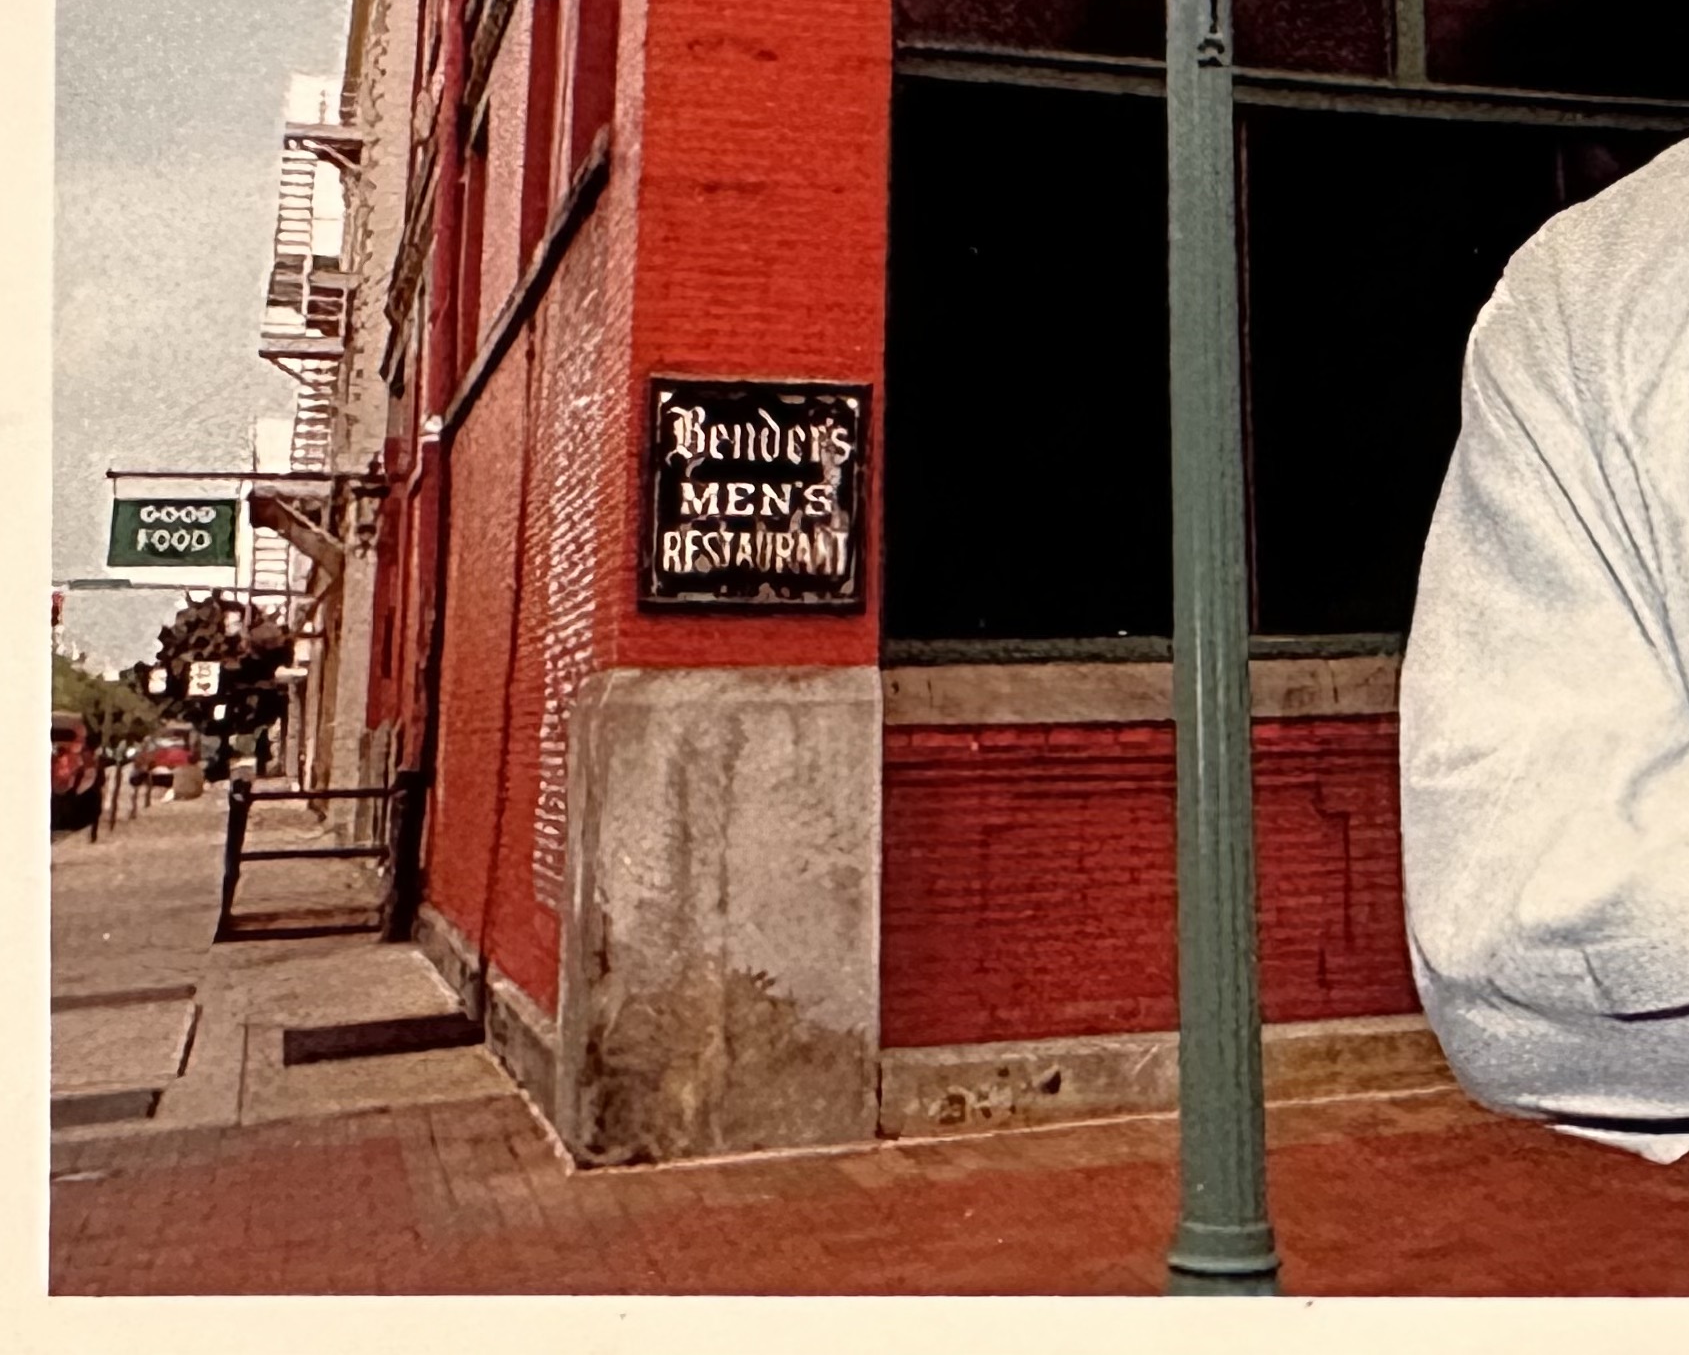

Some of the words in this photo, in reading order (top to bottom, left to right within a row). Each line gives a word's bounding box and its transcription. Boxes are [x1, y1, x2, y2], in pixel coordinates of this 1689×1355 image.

[665, 405, 852, 478] Bender's
[140, 505, 217, 524] GOOD
[679, 480, 834, 516] MEN'S
[136, 528, 213, 552] FOOD
[662, 529, 848, 575] RESTAURANT
